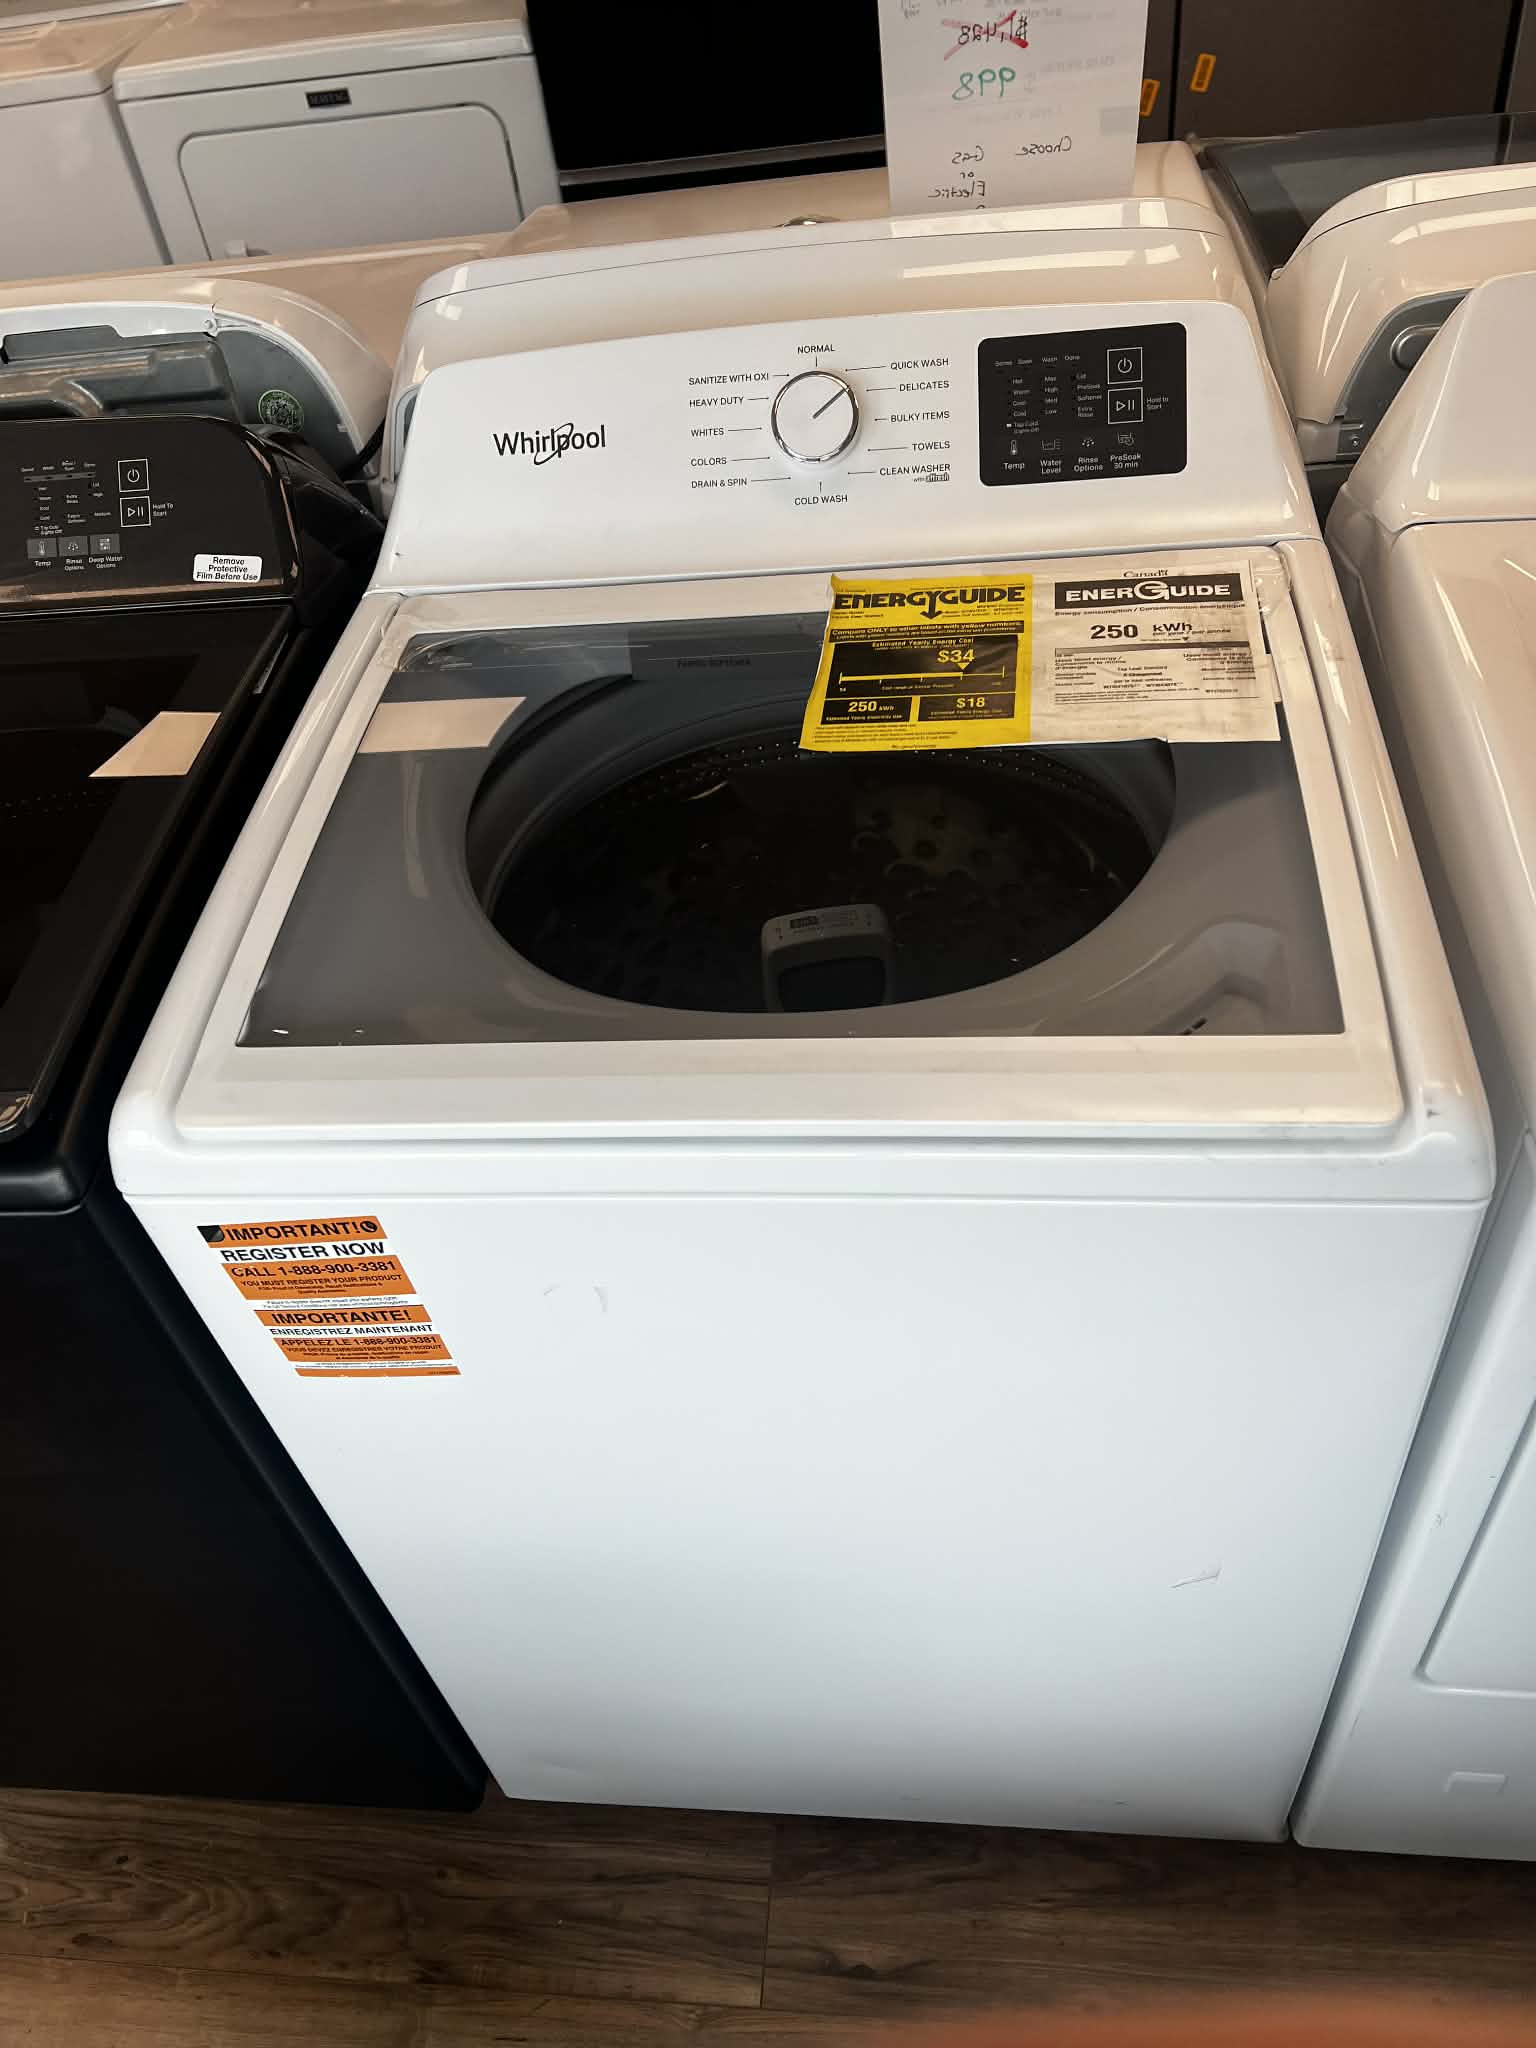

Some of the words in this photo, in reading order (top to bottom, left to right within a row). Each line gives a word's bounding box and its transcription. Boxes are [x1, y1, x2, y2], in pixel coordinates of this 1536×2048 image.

[797, 344, 835, 354] NORMAL
[890, 359, 919, 370] QUICK
[921, 358, 949, 368] WASH
[688, 375, 728, 386] SANITIZE
[729, 374, 752, 383] WITH
[753, 372, 769, 381] OXI
[899, 381, 950, 392] DELICATES
[689, 398, 718, 408] HEAVY
[720, 396, 744, 405] DUTY
[890, 413, 920, 423] BULKY
[922, 411, 950, 421] ITEMS
[690, 427, 724, 437] WHITES
[492, 422, 606, 465] Whirlpool
[911, 441, 951, 451] TOWELS
[690, 457, 727, 466] COLORS
[1040, 459, 1061, 467] Water
[1078, 456, 1099, 464] Rinse
[1110, 453, 1141, 461] PreSoak
[879, 466, 910, 476] CLEAN
[912, 464, 951, 474] WASHER
[1003, 462, 1025, 470] Temp
[1074, 464, 1104, 473] Options
[1124, 461, 1139, 469] min
[691, 479, 718, 489] DRAIN
[719, 479, 726, 487] &
[727, 477, 748, 487] SPIN
[794, 496, 819, 506] COLD
[821, 494, 848, 504] WASH
[212, 556, 245, 565] Remove
[208, 564, 248, 573] Protective
[196, 572, 213, 580] Film
[1065, 580, 1231, 602] ENERGUIDE
[835, 586, 1026, 612] ENERGYGUIDE
[866, 627, 888, 635] ONLY
[1090, 624, 1139, 639] 250
[1152, 622, 1193, 632] kWh
[907, 639, 931, 647] Yearly
[932, 638, 957, 647] Energy
[936, 649, 975, 663] $34
[847, 701, 877, 713] 250
[956, 697, 986, 709] $18
[225, 1222, 360, 1241] IMPORTANT!
[220, 1245, 332, 1262] REGISTER
[333, 1242, 385, 1257] NOW
[231, 1266, 275, 1278] CALL
[277, 1261, 396, 1277] 1-888-900-3381
[358, 1274, 402, 1282] PRODUCT
[271, 1310, 411, 1325] IMPORTANTE!
[269, 1326, 353, 1336] ENREGISTREZ
[354, 1324, 433, 1335] MAINTENANT
[281, 1338, 332, 1347] APPELEZ
[334, 1338, 351, 1346] LE
[353, 1336, 437, 1346] 1-888-900-3381
